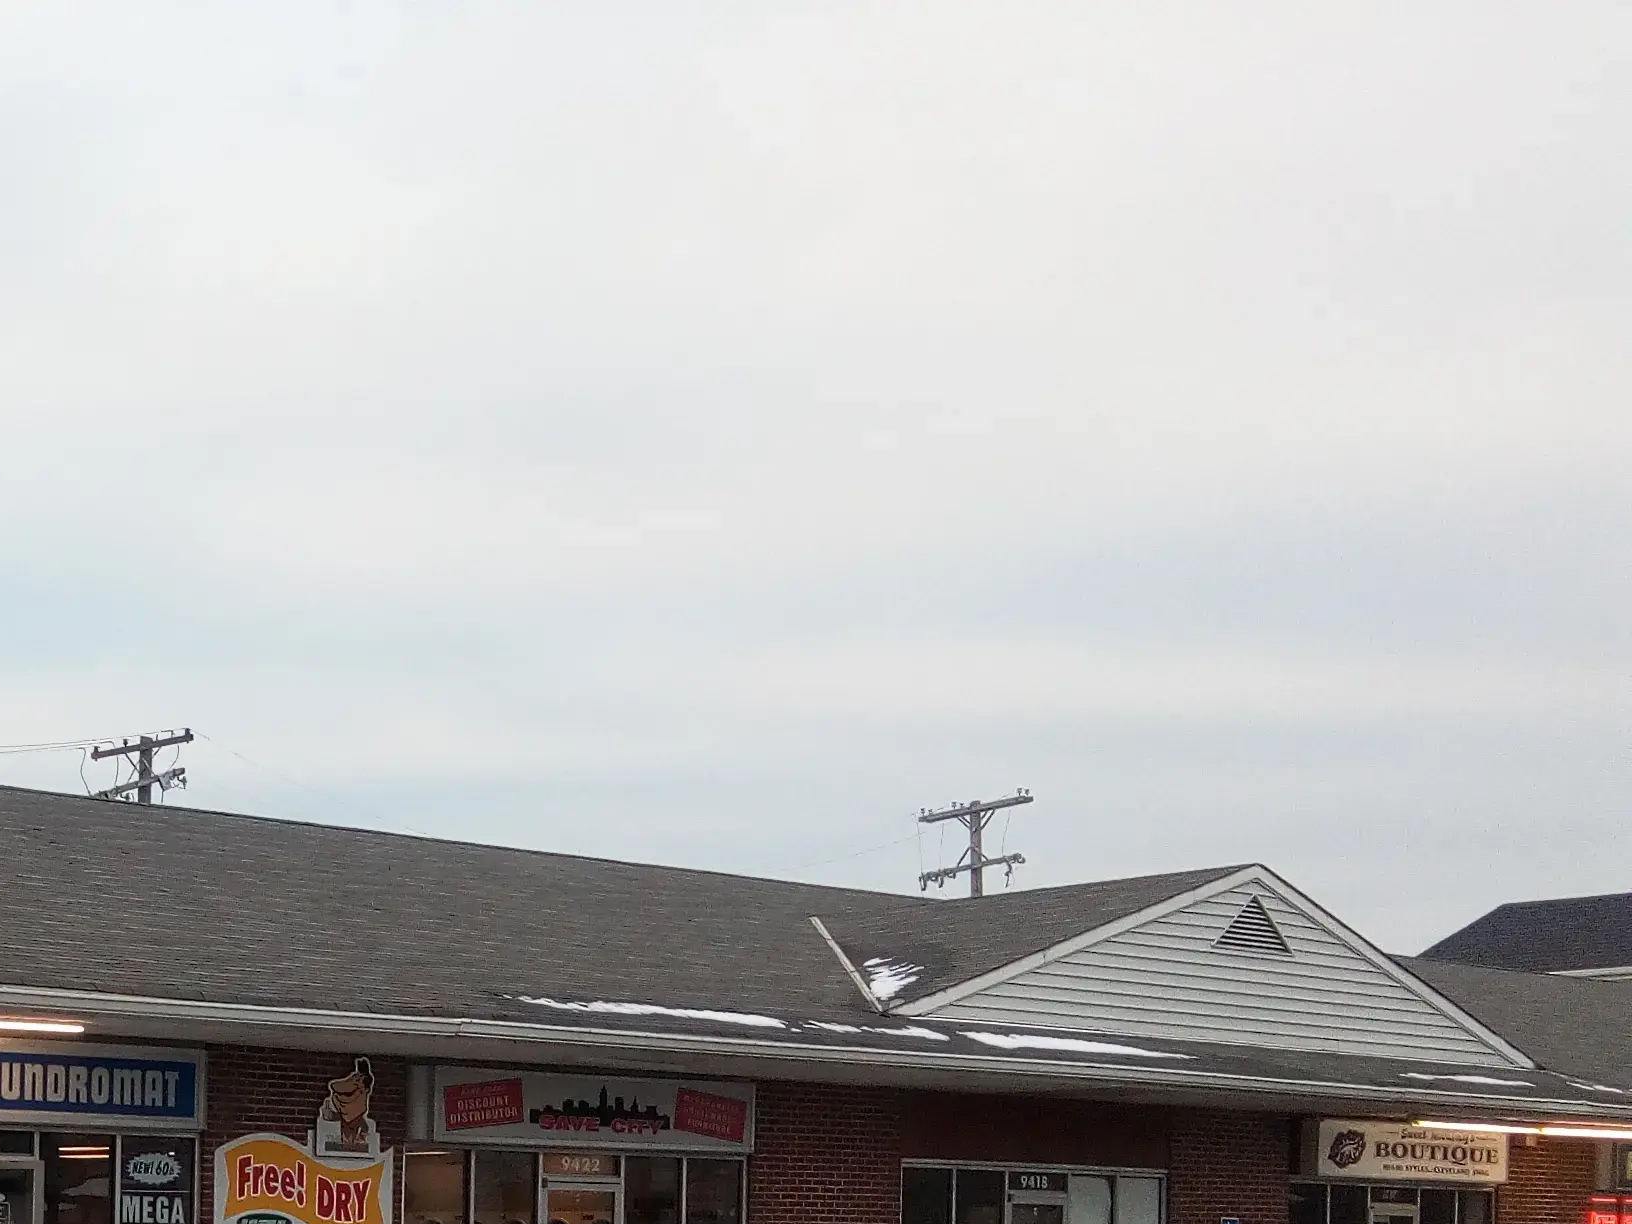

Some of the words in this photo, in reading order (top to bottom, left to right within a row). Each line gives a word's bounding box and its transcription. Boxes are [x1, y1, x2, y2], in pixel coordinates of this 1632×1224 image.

[457, 1095, 510, 1110] DISCOUNT
[450, 1106, 518, 1124] DISTRIBUTOR
[539, 1115, 600, 1132] SAVE
[1375, 1141, 1499, 1165] BOUTIQUE
[562, 1156, 601, 1171] 9422
[237, 1154, 307, 1208] Free!
[316, 1173, 371, 1223] DRY
[122, 1196, 185, 1224] MEGA
